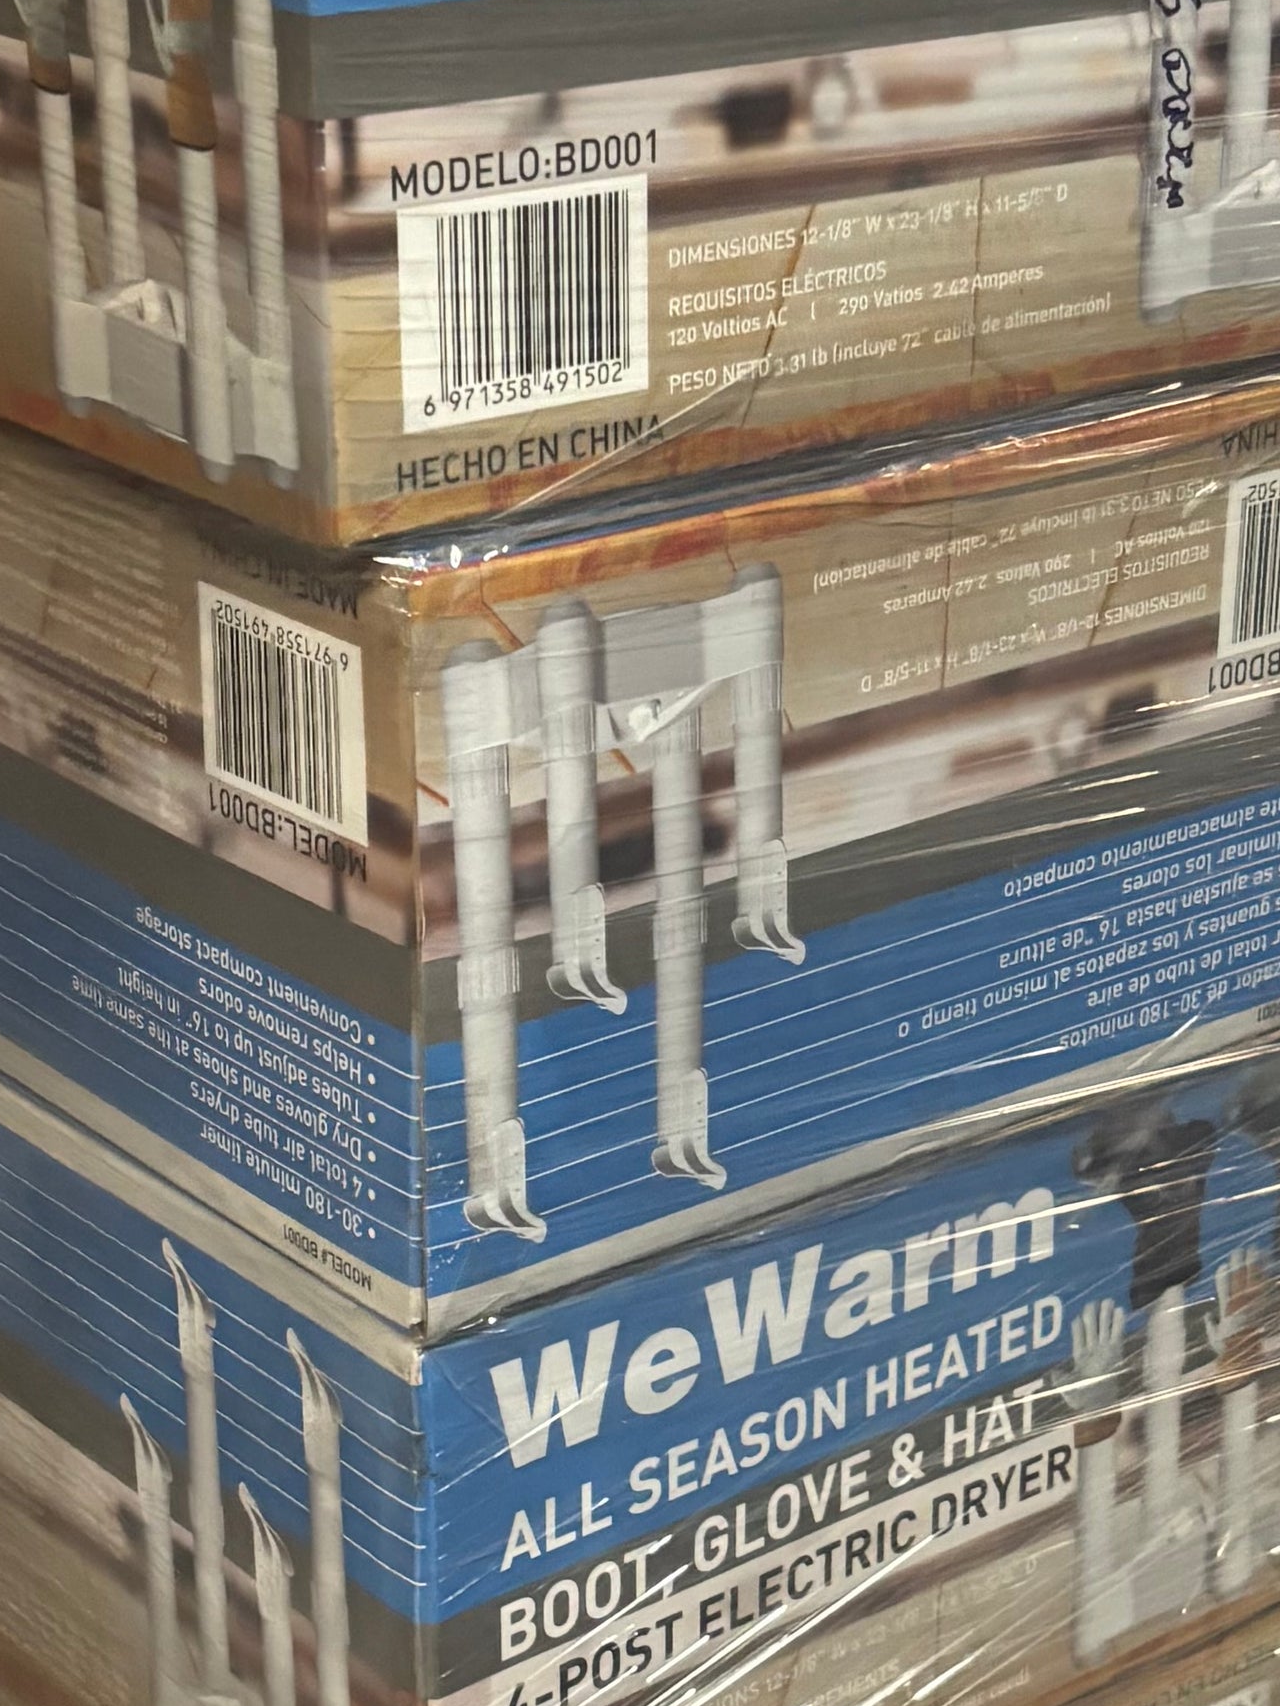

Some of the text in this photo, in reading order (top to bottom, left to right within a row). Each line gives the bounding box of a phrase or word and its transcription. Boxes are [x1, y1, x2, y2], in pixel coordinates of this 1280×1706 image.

[390, 128, 659, 202] MODELO:BD001
[669, 227, 797, 270] DIMENSIONES
[669, 260, 888, 318] REQUISITOS ELÉCTRICOS
[838, 296, 870, 316] 290
[873, 284, 924, 310] Vatios
[971, 262, 1045, 295] Amperes
[667, 306, 789, 347] 120 Voltios AC
[423, 360, 625, 417] 6 971358 491502
[396, 414, 666, 494] HECHO EN CHINA
[208, 782, 367, 883] MODEL:BD001
[135, 907, 363, 1042] Convenient compact storage
[197, 977, 363, 1086] Helps remove odors
[200, 1122, 363, 1236] 30-180 minute timer
[283, 1224, 371, 1291] MODEL# BD001
[489, 1188, 1056, 1470] WeWarm
[499, 1295, 1064, 1574] ALL SEASON HEATED
[691, 1447, 874, 1572] GLOVE
[886, 1436, 927, 1491] &
[942, 1383, 1047, 1469] HAT
[698, 1504, 916, 1641] ELECTRIC
[930, 1443, 1074, 1538] DRYER
